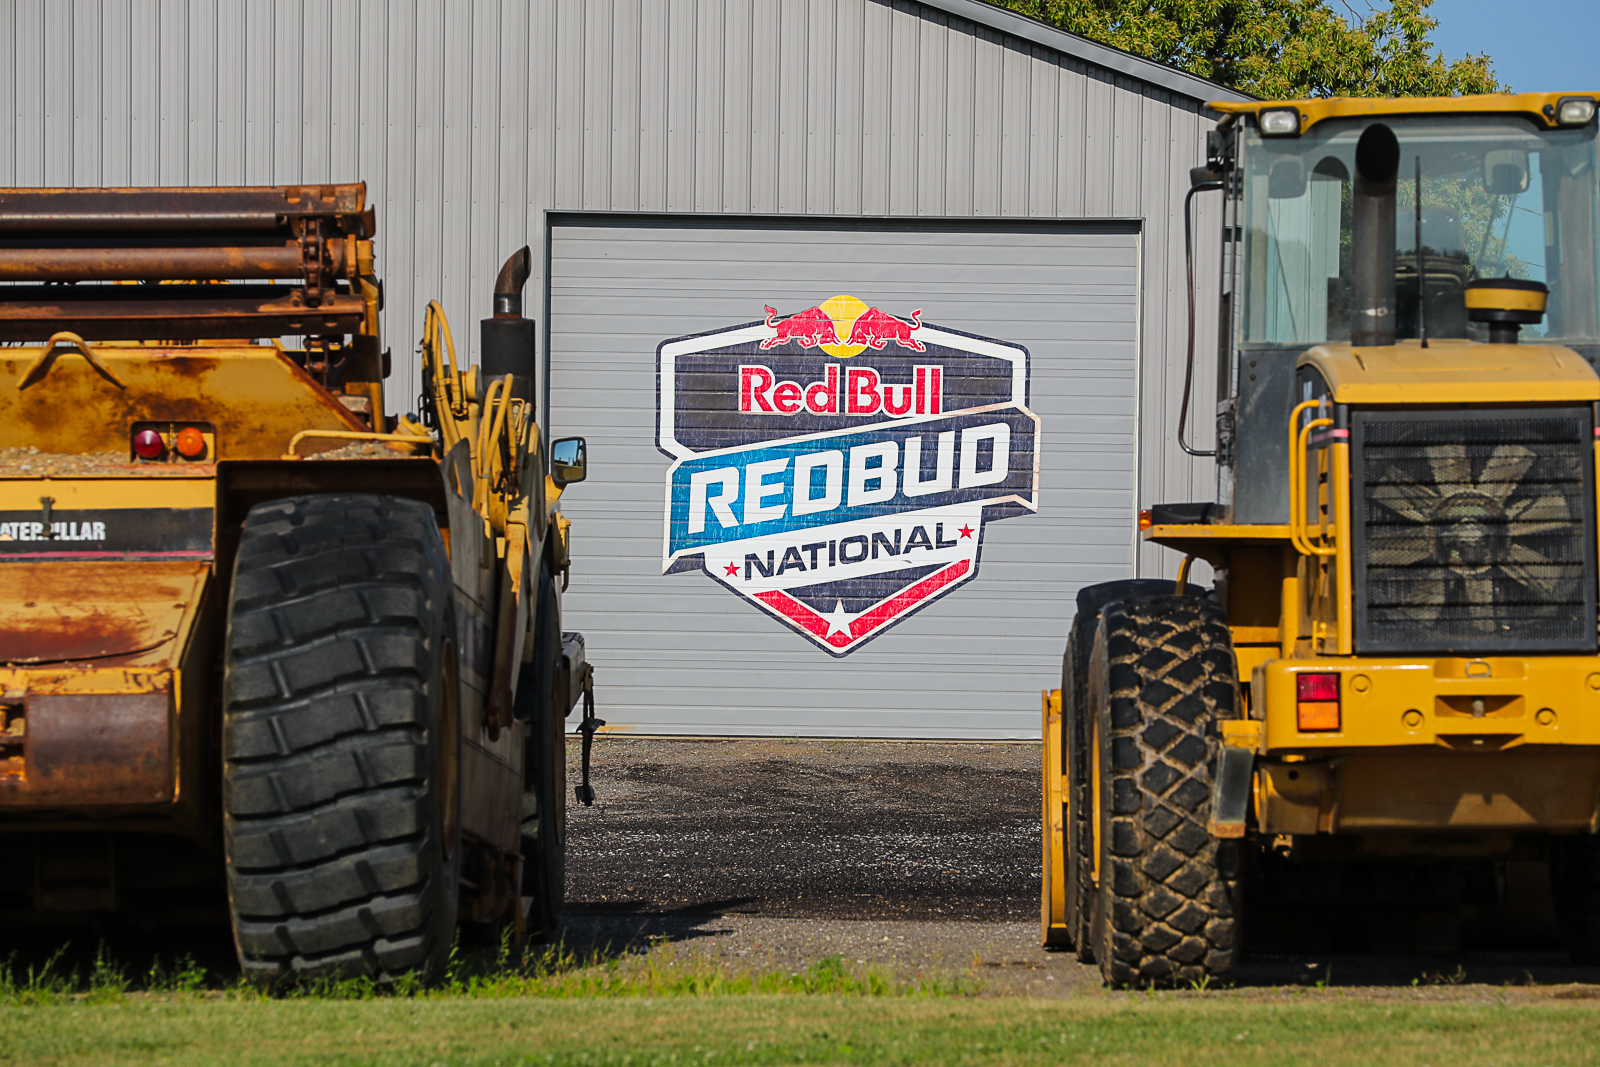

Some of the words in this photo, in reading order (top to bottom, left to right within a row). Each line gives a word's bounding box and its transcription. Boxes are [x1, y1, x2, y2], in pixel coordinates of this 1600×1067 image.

[738, 364, 842, 415] Red
[847, 365, 943, 418] Bull
[688, 422, 1011, 535] REDBUD
[0, 522, 106, 541] ATERILLAR
[744, 522, 958, 581] NATIONAL
